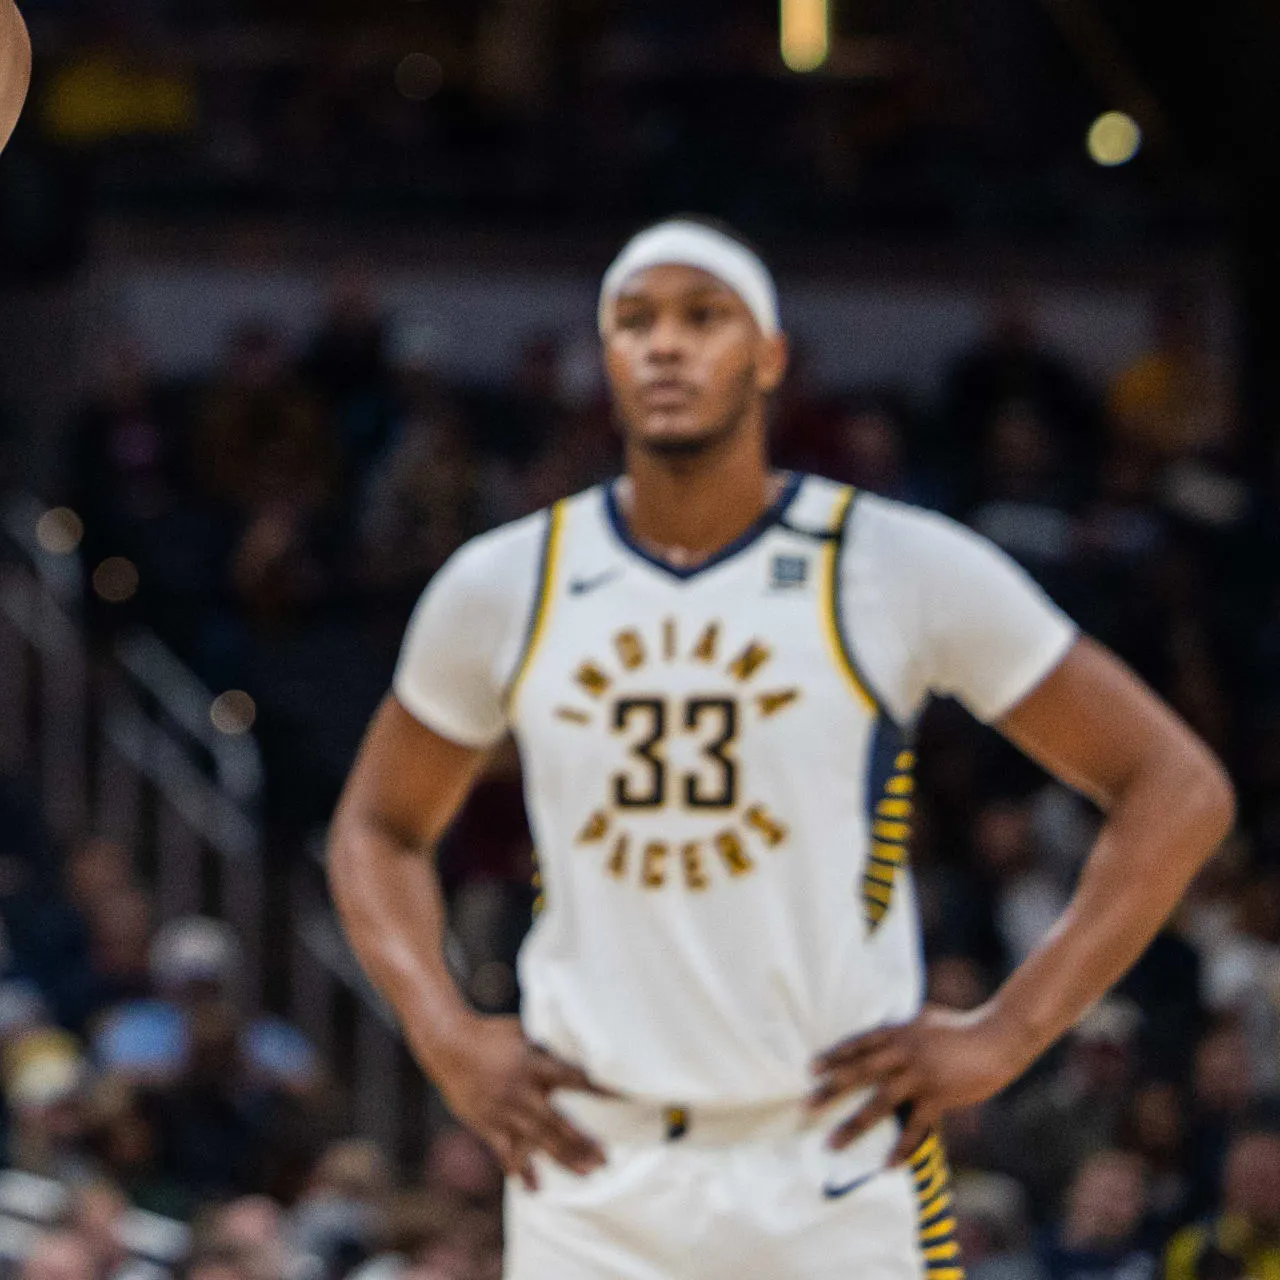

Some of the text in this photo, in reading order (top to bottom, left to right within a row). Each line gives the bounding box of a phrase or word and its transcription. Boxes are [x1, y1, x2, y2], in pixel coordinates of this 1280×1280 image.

[553, 619, 801, 727] INDIANA
[611, 695, 740, 811] 33
[575, 803, 790, 892] PACERS
